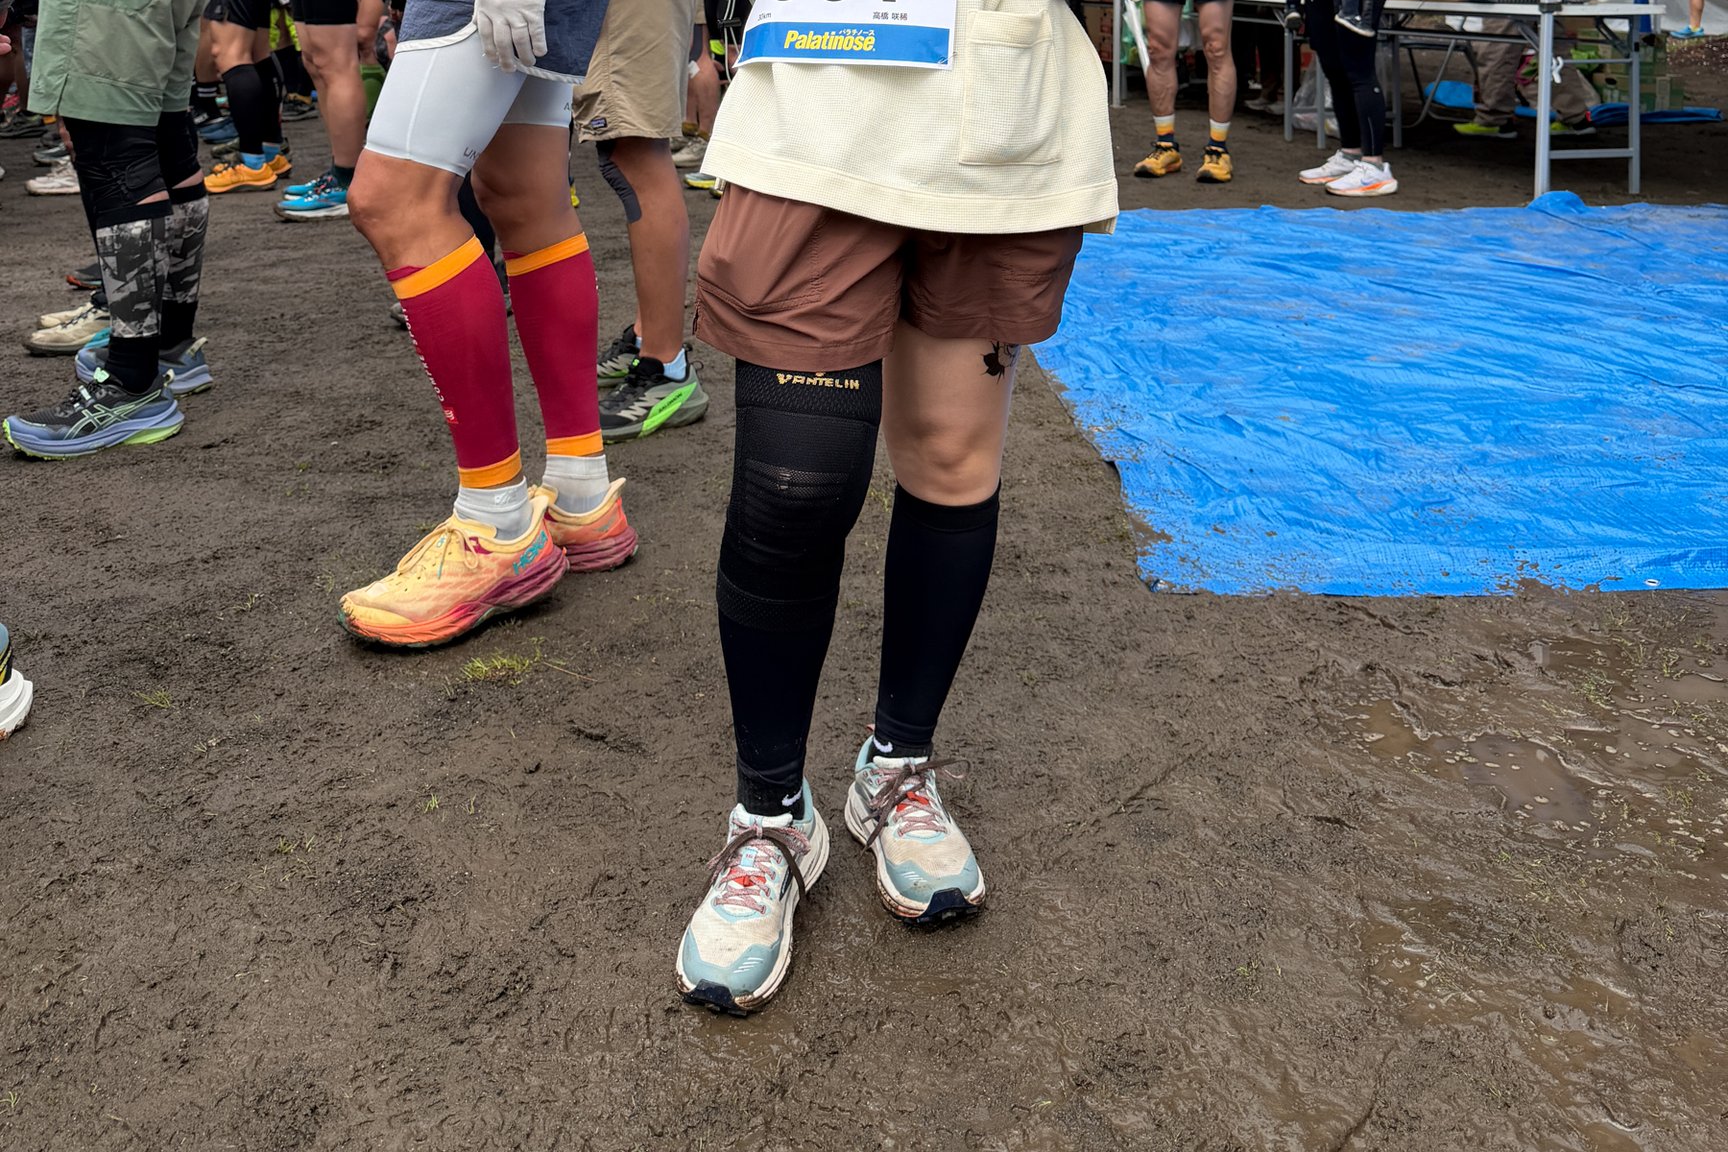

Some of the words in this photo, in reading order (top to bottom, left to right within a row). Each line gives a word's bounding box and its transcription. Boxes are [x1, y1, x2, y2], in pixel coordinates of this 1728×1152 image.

[783, 29, 877, 52] Palatinose
[775, 372, 860, 390] VANTELIN
[512, 530, 549, 576] HOKA
